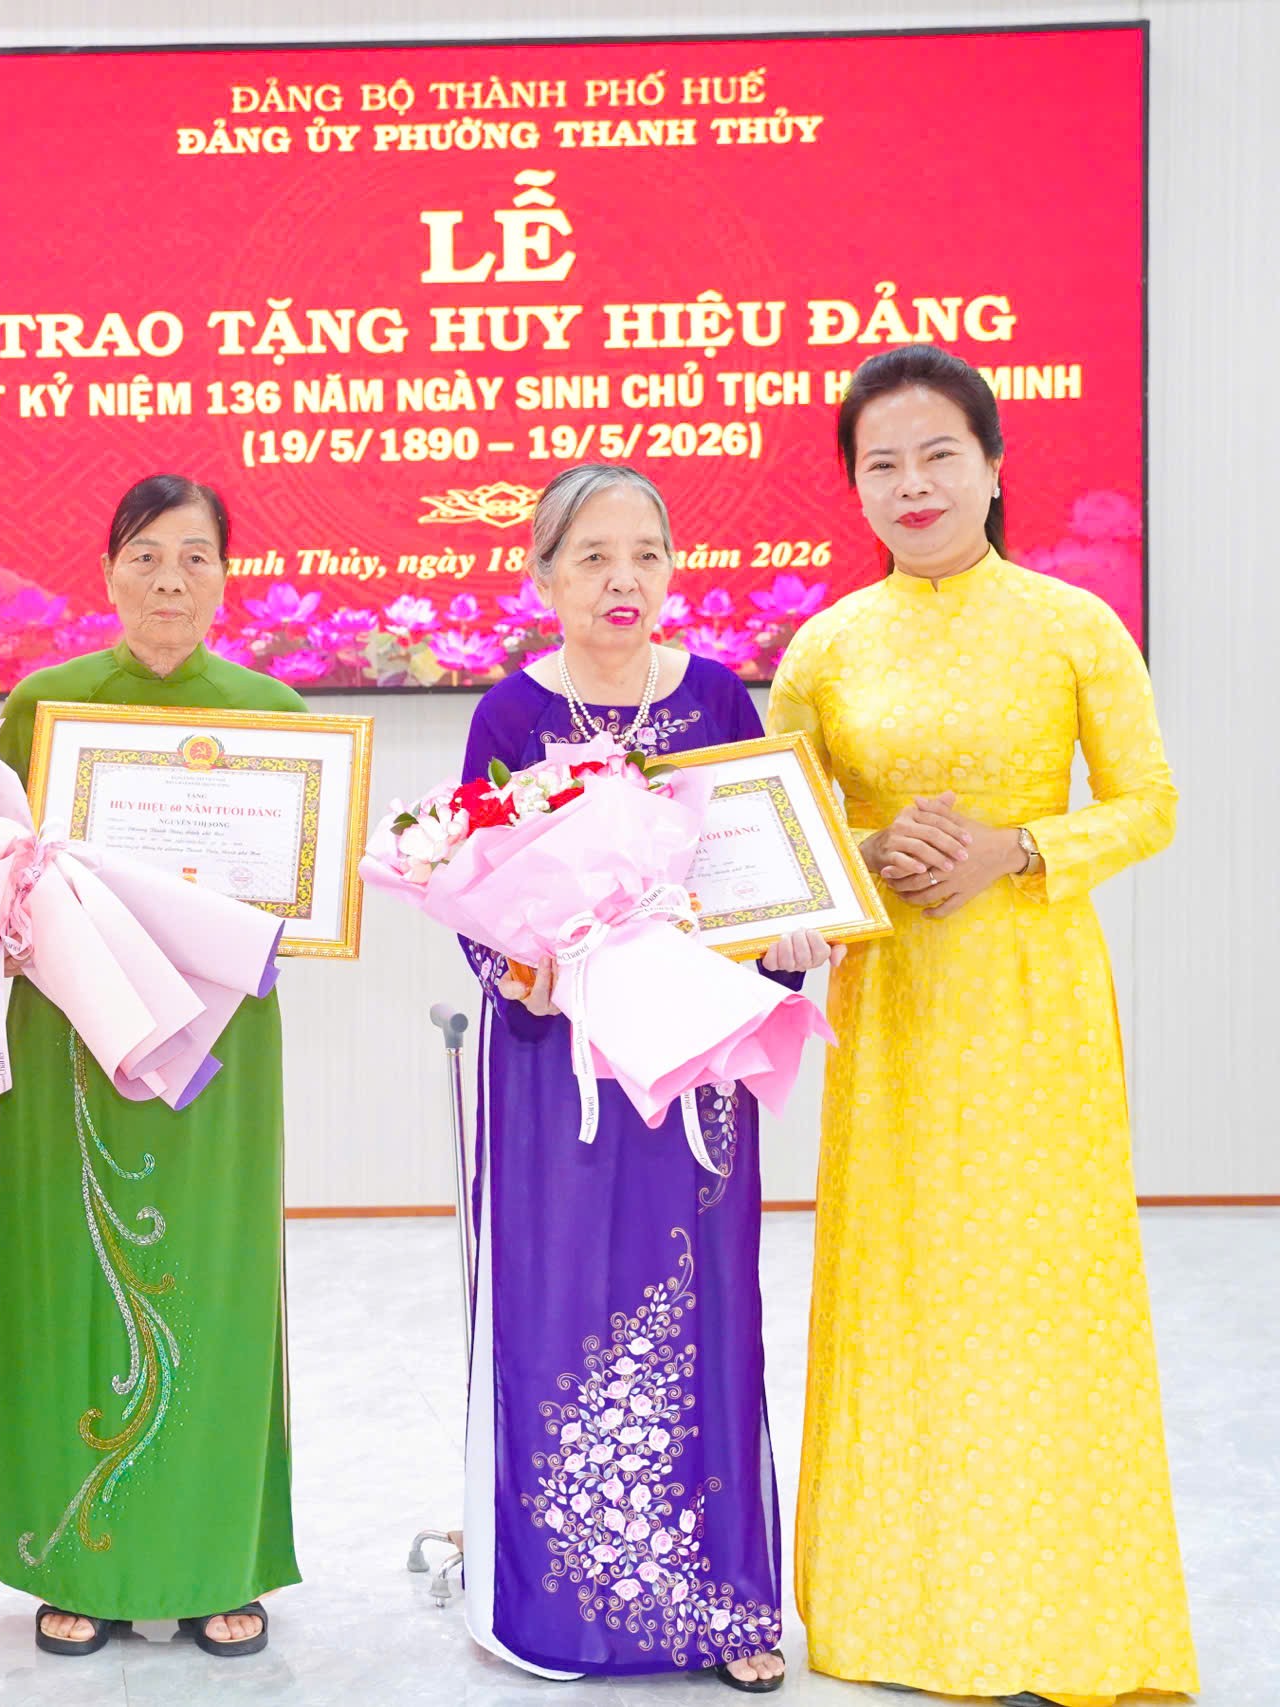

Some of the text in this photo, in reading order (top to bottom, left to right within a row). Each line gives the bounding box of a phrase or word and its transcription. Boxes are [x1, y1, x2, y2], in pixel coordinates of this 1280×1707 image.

[232, 68, 767, 116] ĐẢNG BỘ THÀNH PHỐ HUẾ
[177, 107, 824, 154] ĐẢNG ỦY PHƯỜNG THANH THỦY
[420, 169, 576, 283] LỄ
[207, 298, 408, 366] TẶNG
[430, 305, 583, 352] HUY
[603, 290, 786, 358] HIỆU
[808, 281, 1016, 346] ĐẢNG
[20, 371, 74, 418] KỶ
[89, 374, 192, 423] NIỆM
[207, 380, 282, 415] 136
[294, 373, 384, 413] NĂM
[397, 369, 504, 412] NGÀY
[515, 374, 609, 410] SINH
[622, 361, 704, 408] CHỦ
[717, 372, 810, 414] TỊCH
[824, 370, 853, 404] H
[993, 364, 1082, 400] MINH
[242, 427, 479, 467] (19/5/1890
[528, 422, 762, 461] 19/5/2026)
[225, 550, 285, 577] anh
[297, 547, 387, 581] Thủy,
[397, 547, 476, 580] ngày
[673, 542, 740, 570] năm
[750, 541, 832, 568] 2026
